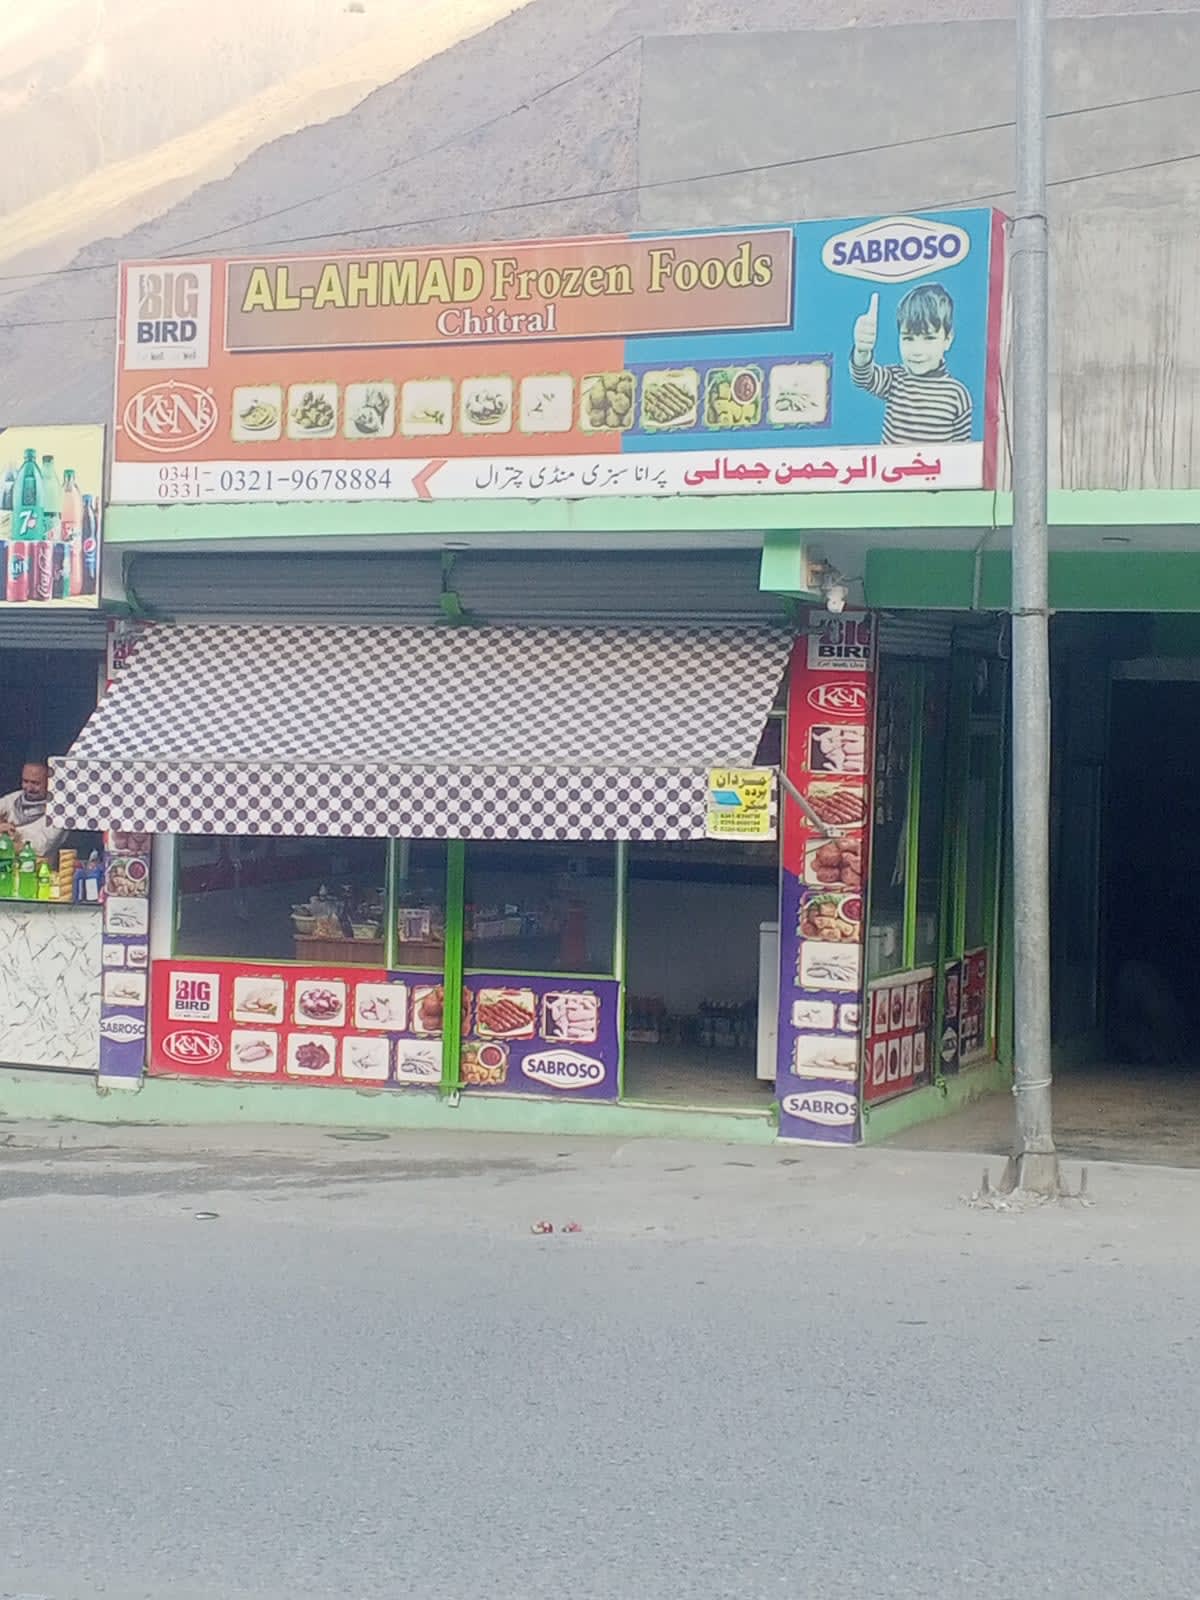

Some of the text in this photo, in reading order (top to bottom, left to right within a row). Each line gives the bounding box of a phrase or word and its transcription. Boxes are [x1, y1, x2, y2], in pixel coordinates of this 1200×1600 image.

[831, 233, 962, 267] SABROSO
[241, 242, 773, 312] AL-AHMAD Frozen Foods
[138, 271, 199, 320] BIG
[137, 319, 198, 344] BIRD
[436, 304, 557, 337] Chitral
[220, 467, 393, 492] 0321-9678884
[475, 463, 668, 490] پرانا سبزی منڈی چترال
[175, 980, 211, 1001] BIG
[175, 1000, 210, 1011] BIRD
[527, 1059, 600, 1079] SABROSO
